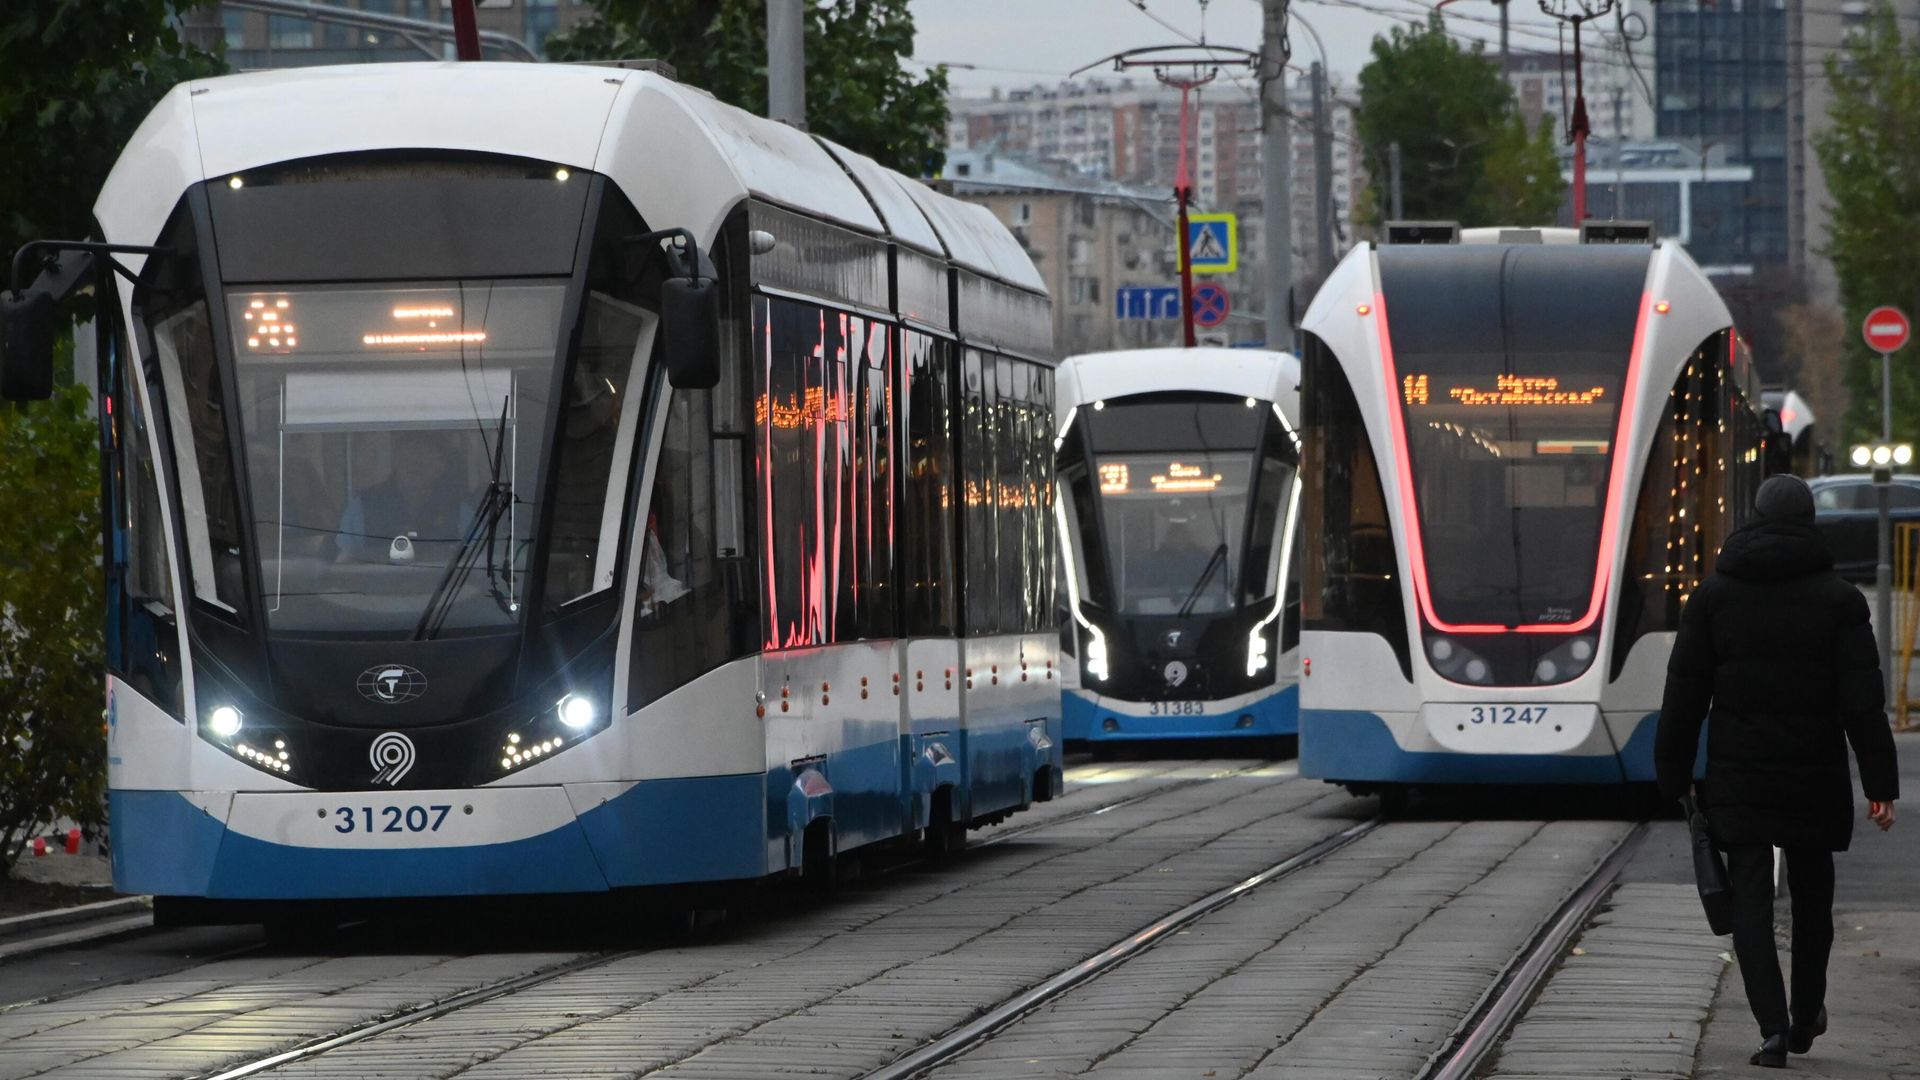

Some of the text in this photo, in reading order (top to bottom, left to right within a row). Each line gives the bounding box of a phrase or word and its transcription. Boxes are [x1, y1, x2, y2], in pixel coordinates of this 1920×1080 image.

[1403, 374, 1429, 405] 14
[1150, 702, 1204, 715] 31383
[1470, 707, 1548, 725] 31247
[334, 805, 452, 833] 31207
